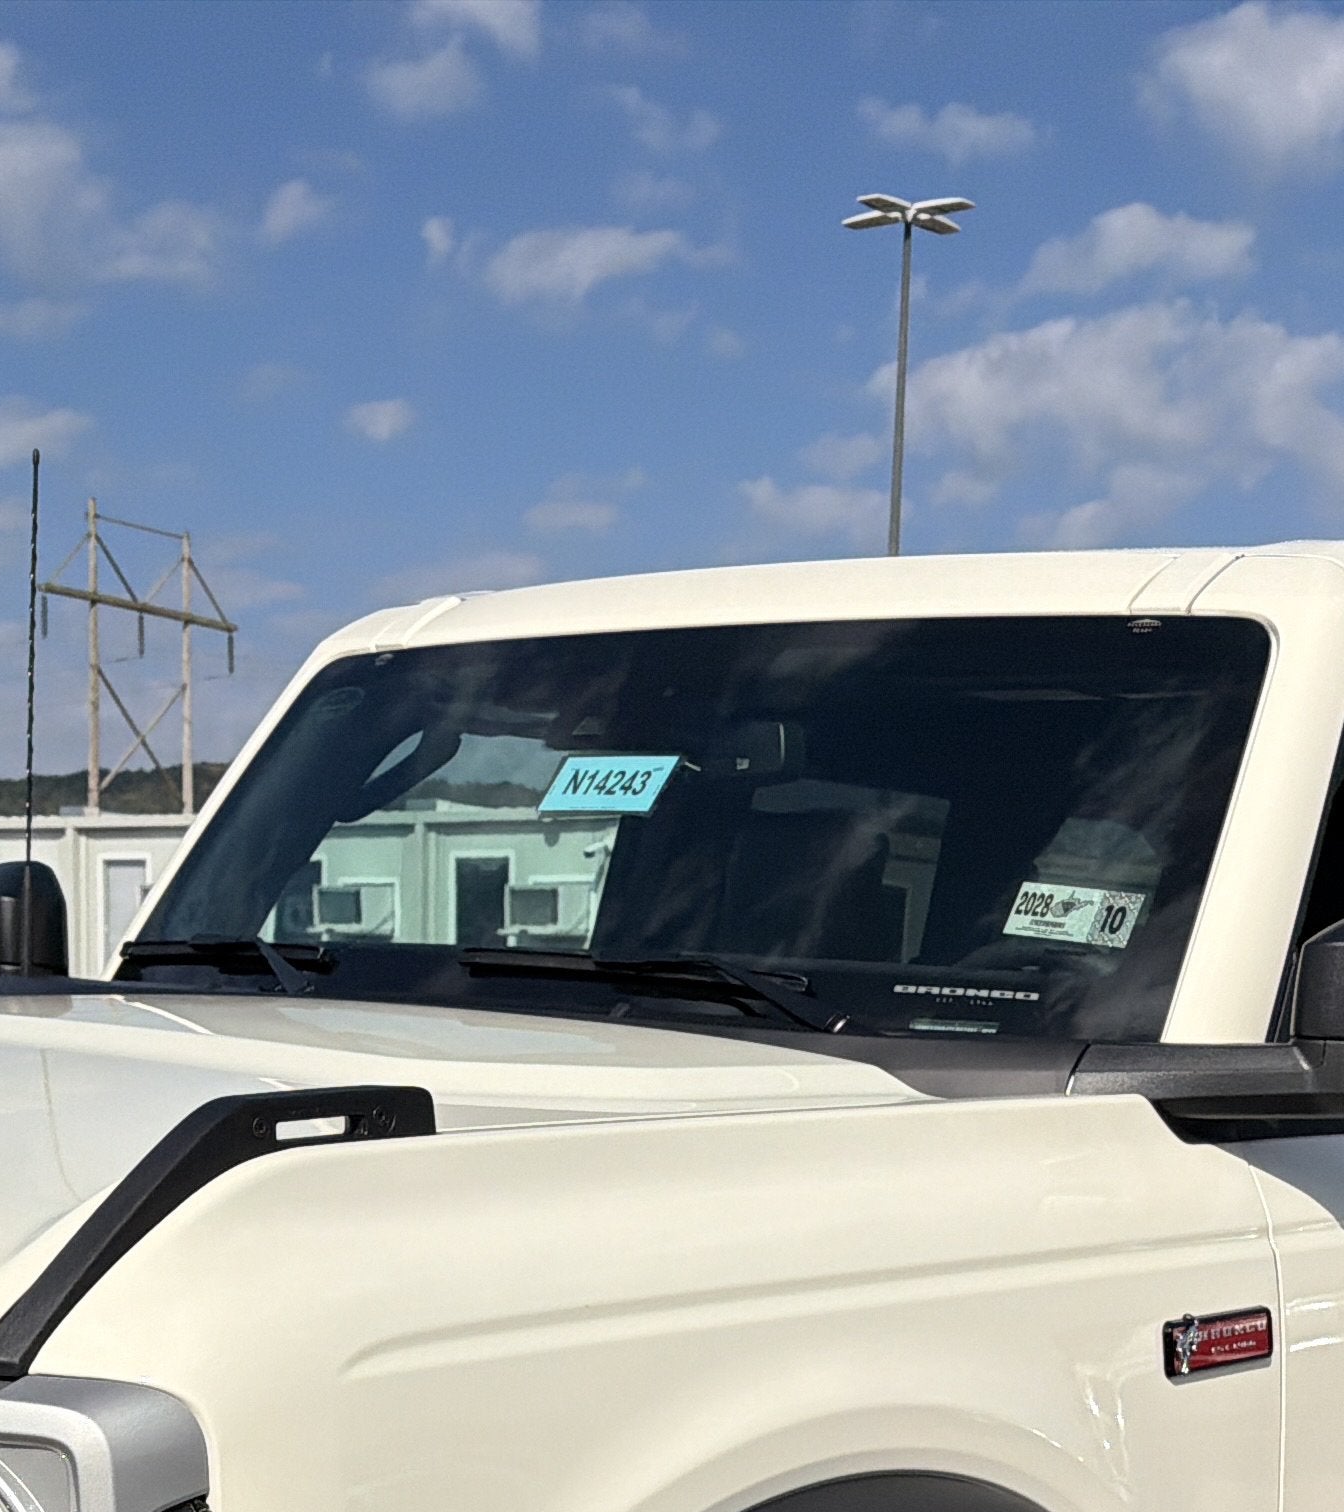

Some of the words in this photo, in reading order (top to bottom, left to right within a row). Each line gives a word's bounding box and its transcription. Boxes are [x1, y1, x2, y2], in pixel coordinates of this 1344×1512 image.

[561, 769, 652, 796] N14243
[1014, 890, 1055, 918] 2028
[1100, 904, 1127, 935] 10
[893, 984, 1040, 1001] BRONCO
